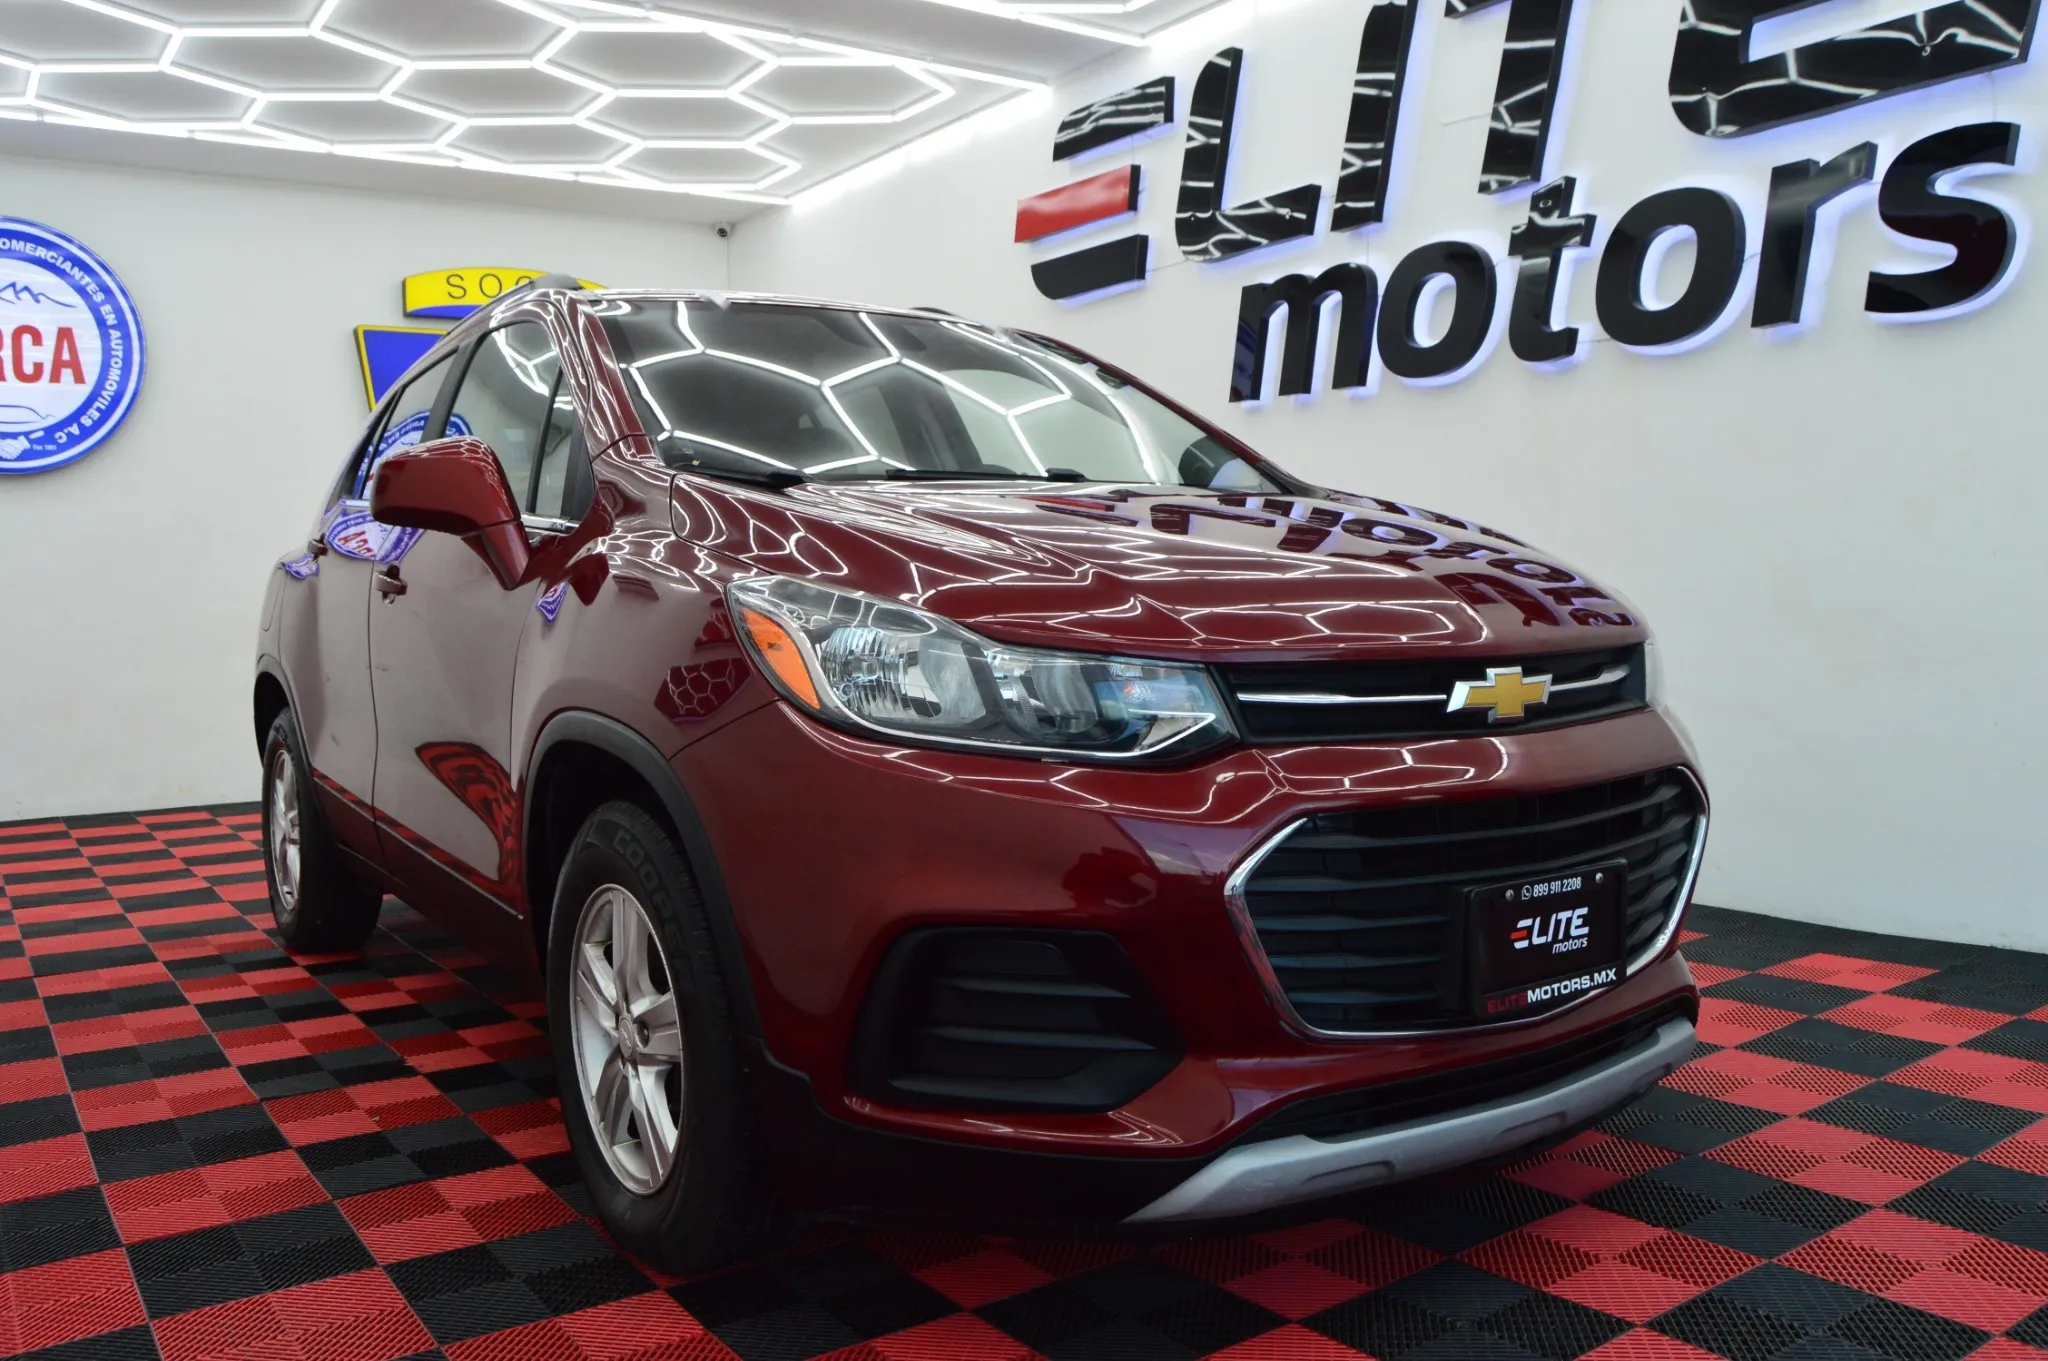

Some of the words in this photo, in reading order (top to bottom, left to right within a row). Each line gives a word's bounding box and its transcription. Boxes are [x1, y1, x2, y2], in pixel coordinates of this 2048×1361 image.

[1228, 121, 2021, 403] motors
[99, 304, 118, 326] EN
[0, 325, 86, 385] CA
[80, 329, 124, 427] AUTOMOVILES
[1533, 883, 1549, 898] 899
[1550, 880, 1562, 894] 911
[1562, 877, 1582, 892] 2208
[1511, 907, 1590, 949] ELITE
[1552, 937, 1588, 954] motors
